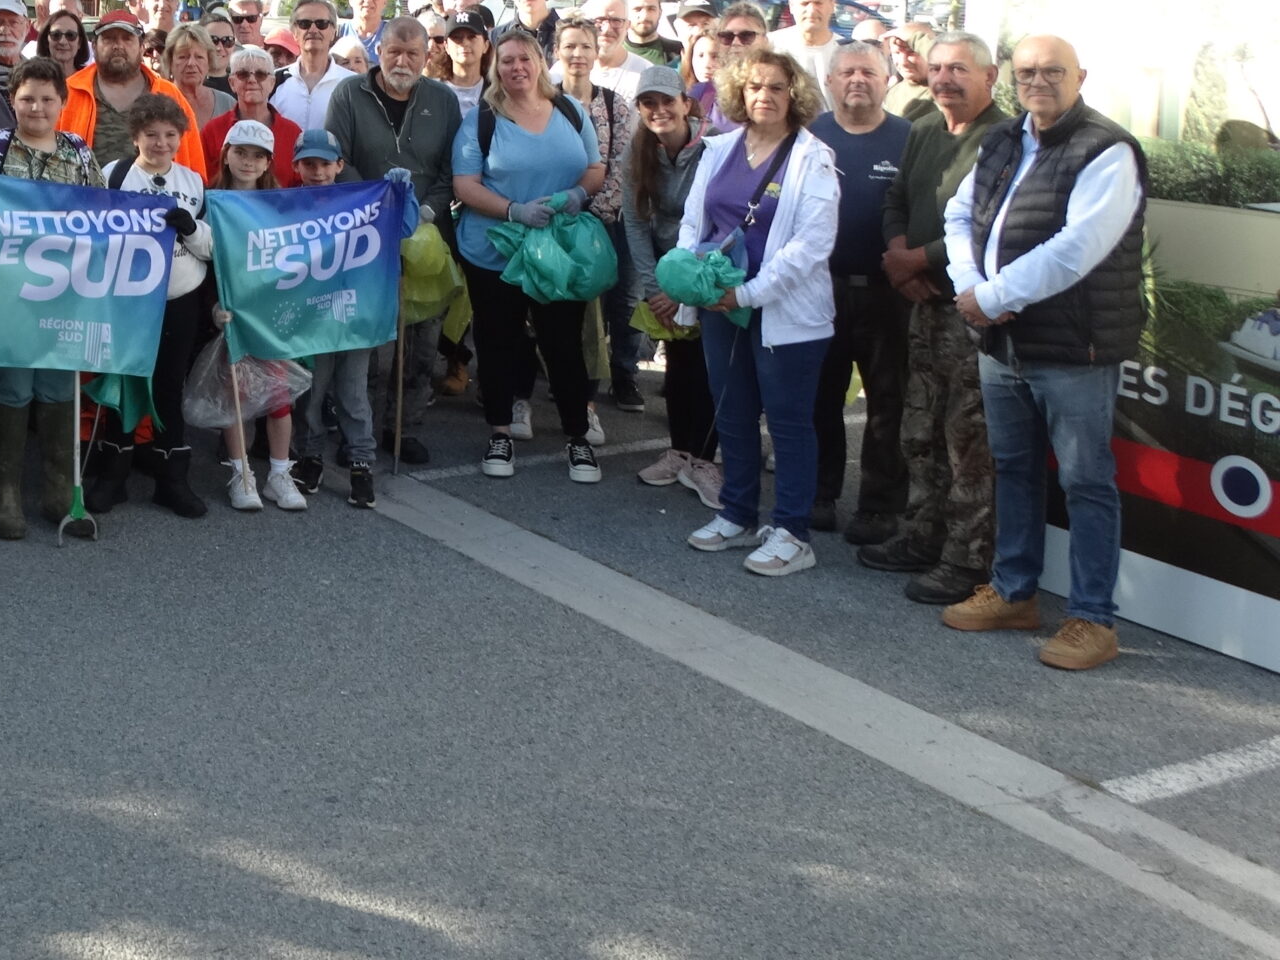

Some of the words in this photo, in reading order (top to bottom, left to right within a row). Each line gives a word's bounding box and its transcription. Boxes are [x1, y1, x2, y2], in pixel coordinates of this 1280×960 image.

[237, 125, 273, 142] NYC
[247, 201, 381, 251] NETTOYONS
[19, 234, 166, 302] SUD
[246, 248, 274, 272] LE
[274, 224, 381, 290] SUD
[39, 316, 84, 331] RÉGION
[57, 330, 83, 342] SUD
[1117, 360, 1169, 406] ES
[1185, 372, 1280, 435] DÉG
